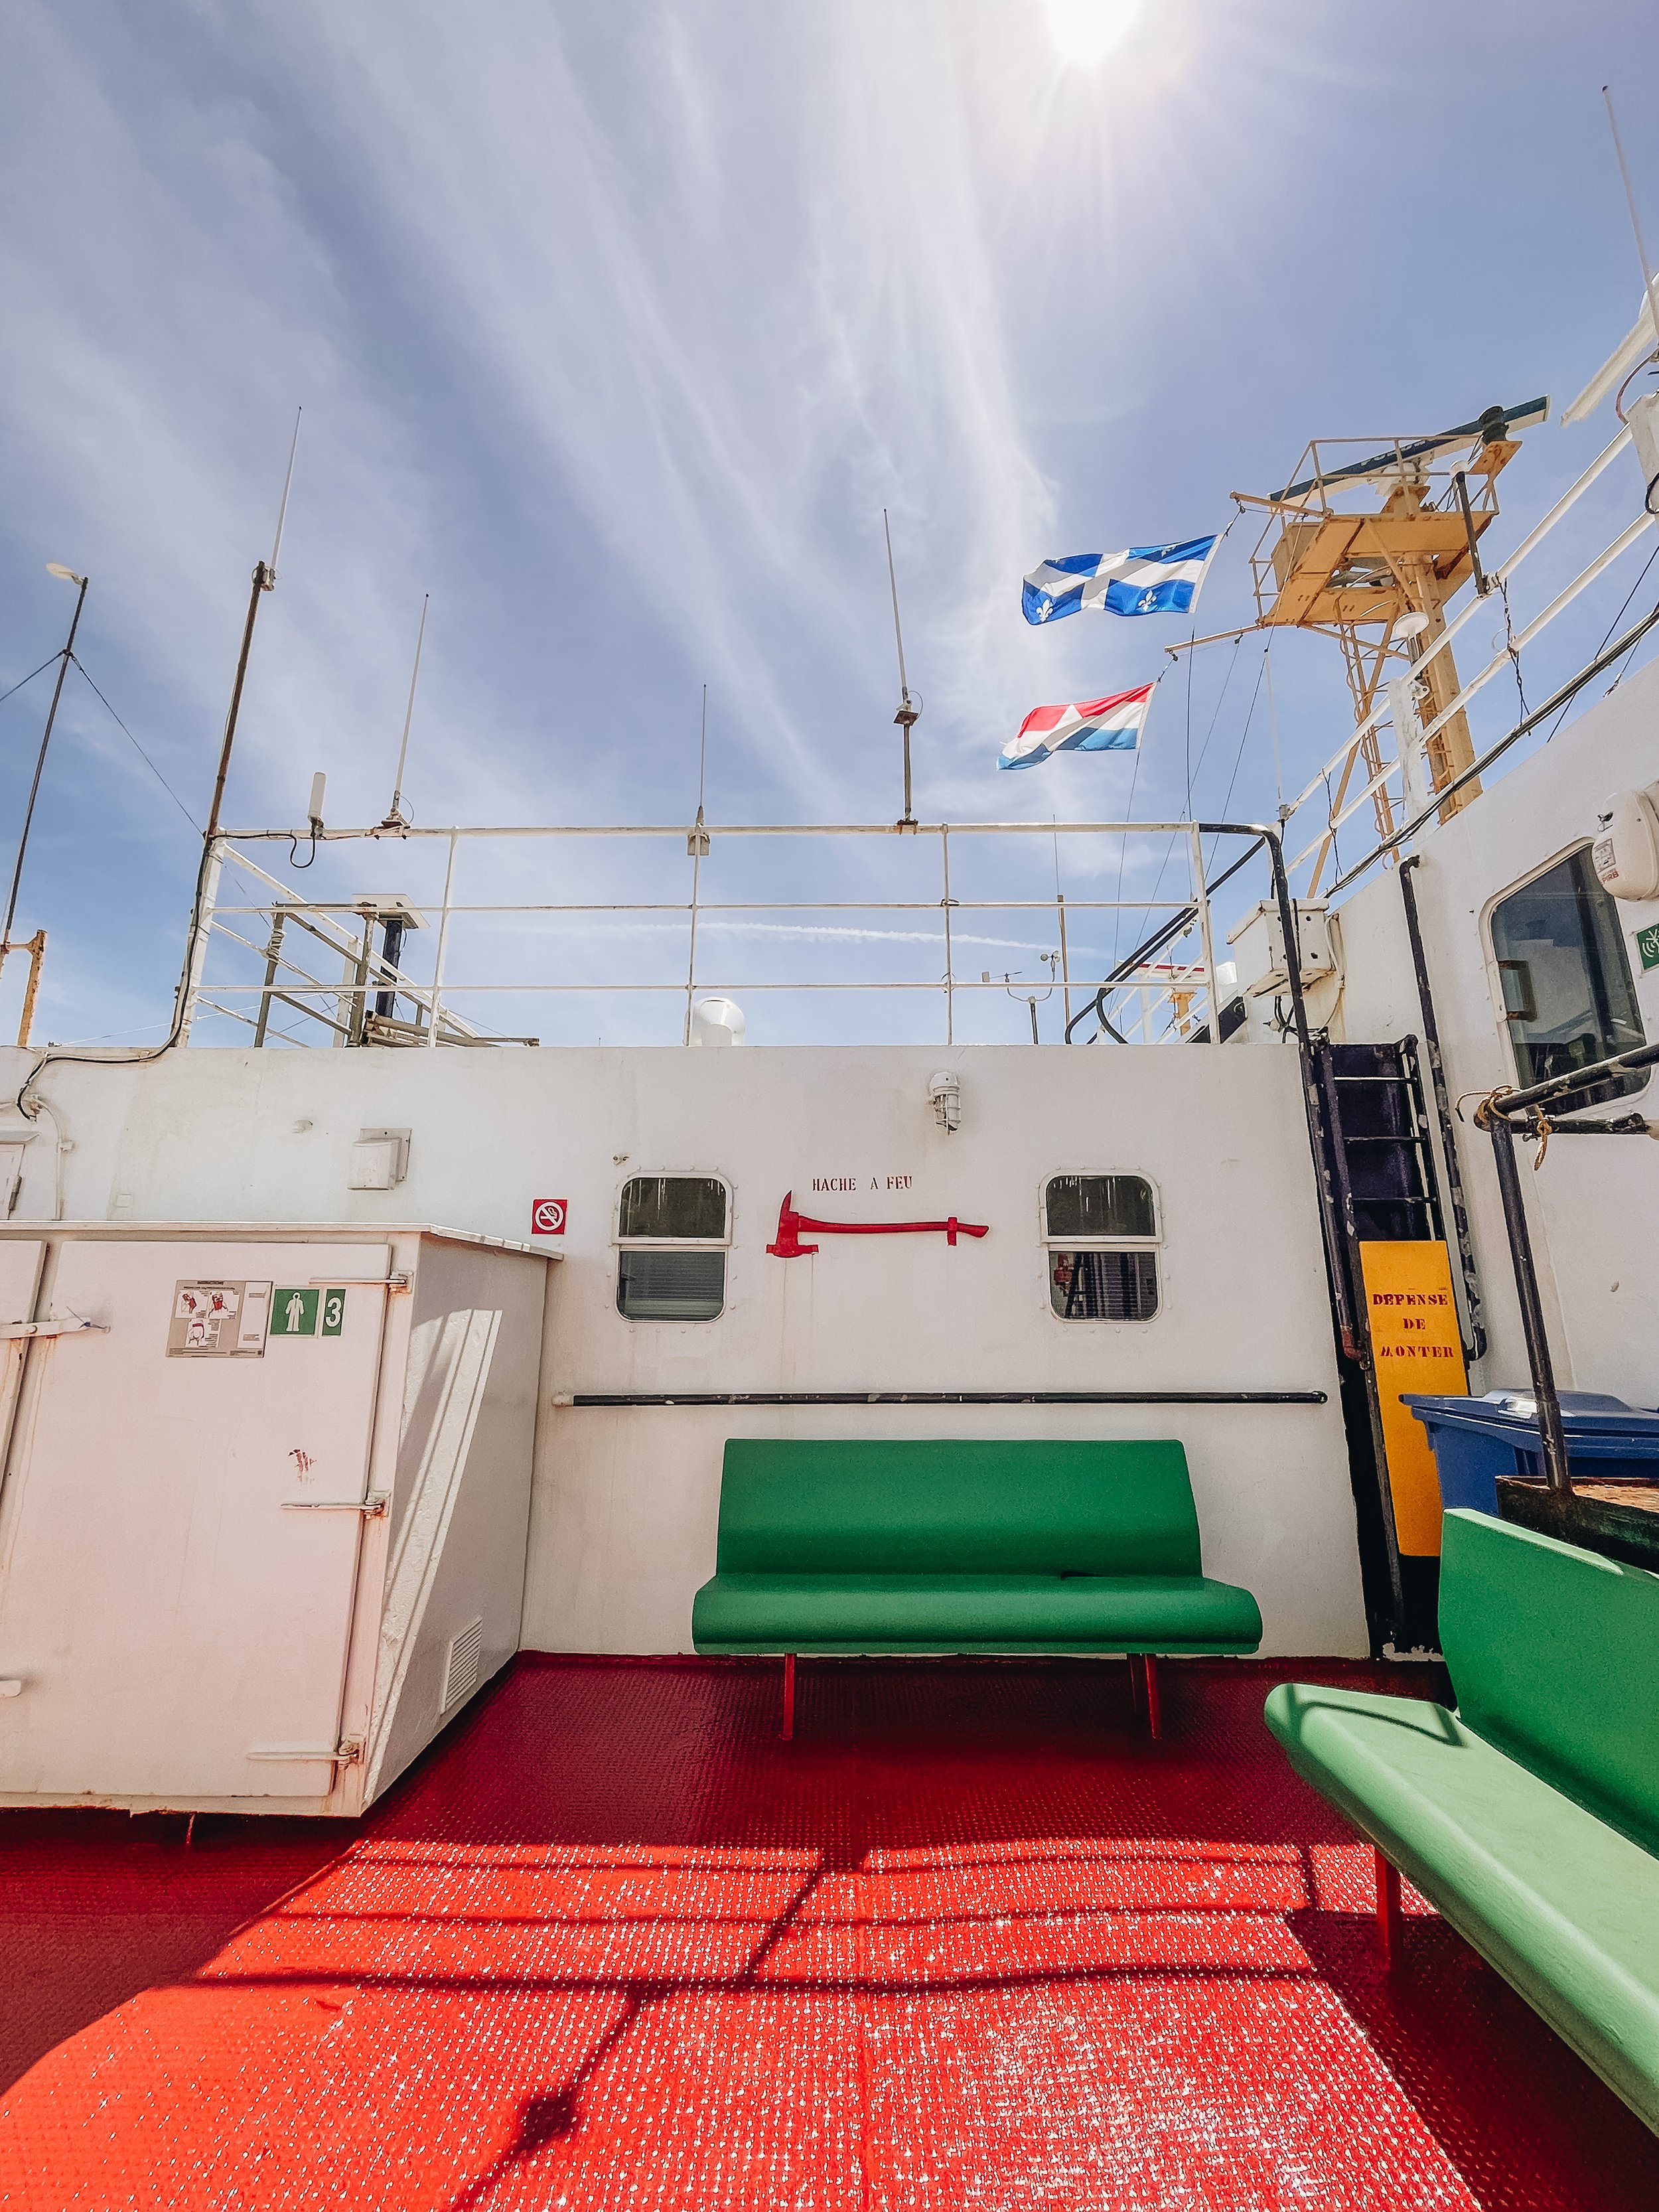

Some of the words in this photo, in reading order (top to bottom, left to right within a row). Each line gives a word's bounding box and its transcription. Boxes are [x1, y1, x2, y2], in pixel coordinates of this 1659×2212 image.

[812, 1178, 856, 1191] HACHE
[870, 1177, 879, 1190] A
[887, 1175, 912, 1189] FEU
[325, 1297, 342, 1327] 3
[1403, 1318, 1425, 1330] DE
[1380, 1345, 1454, 1358] MONTER
